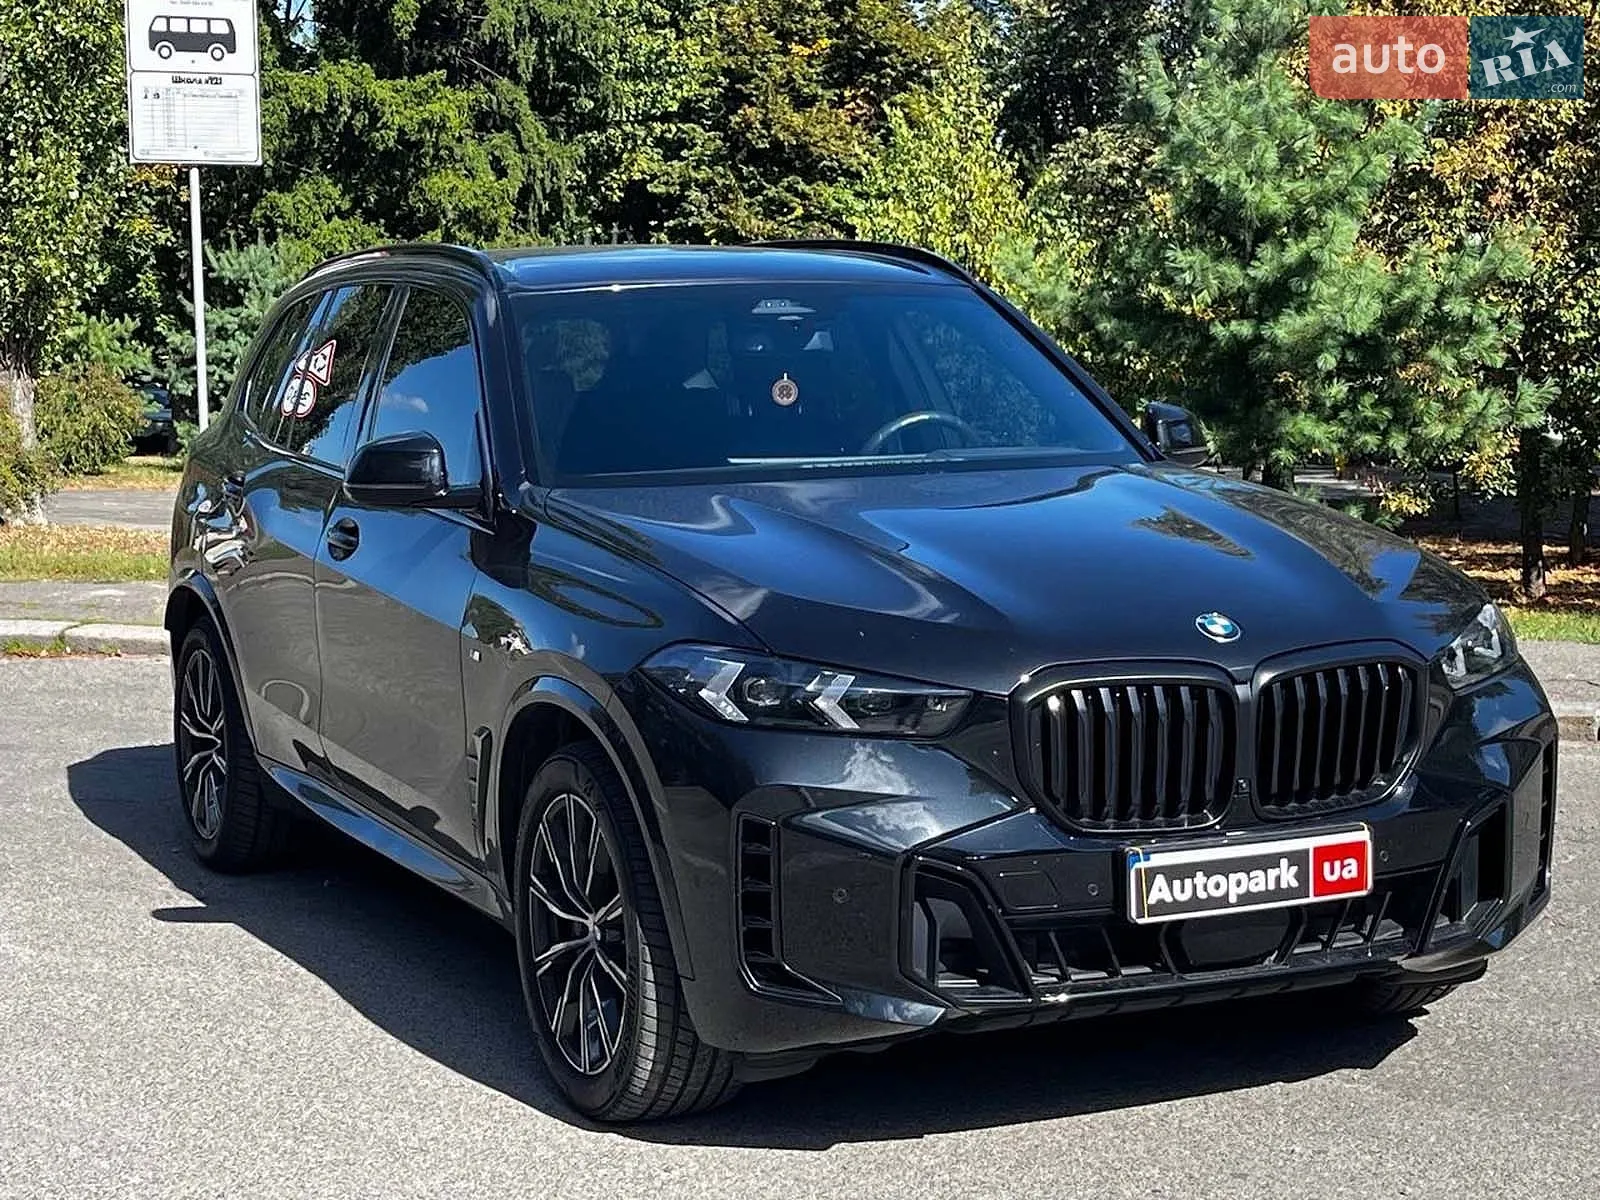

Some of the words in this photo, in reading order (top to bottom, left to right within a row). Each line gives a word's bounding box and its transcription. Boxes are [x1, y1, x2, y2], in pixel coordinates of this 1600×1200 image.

[171, 75, 202, 85] Школа
[1147, 858, 1299, 904] Autopark
[1322, 856, 1358, 882] ua
